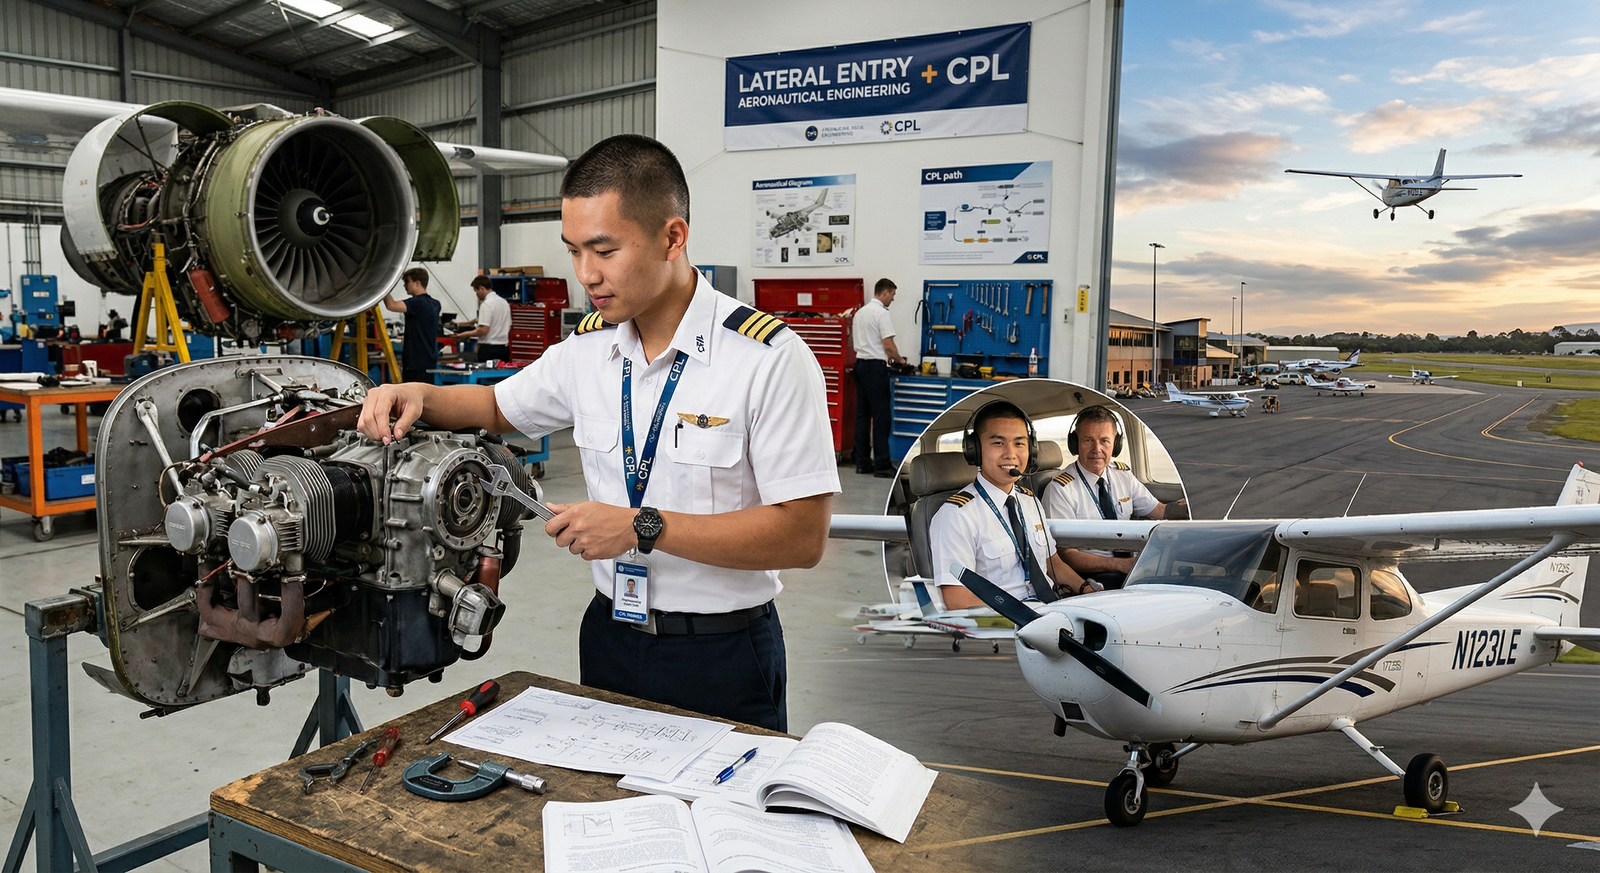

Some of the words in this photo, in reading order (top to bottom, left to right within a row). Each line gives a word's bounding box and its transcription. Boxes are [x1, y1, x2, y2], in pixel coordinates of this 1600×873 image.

[739, 65, 831, 93] LATERAL
[837, 56, 914, 84] ENTRY
[921, 64, 938, 84] +
[946, 53, 1010, 85] CPL
[738, 90, 825, 109] AERONAUTICAL
[826, 82, 911, 101] ENGINEERING
[894, 119, 922, 133] CPL
[925, 172, 942, 181] CPL
[943, 170, 963, 181] path
[669, 358, 685, 382] CPL
[625, 456, 636, 479] CPL
[638, 457, 652, 480] CPL
[1451, 628, 1522, 670] N123LE
